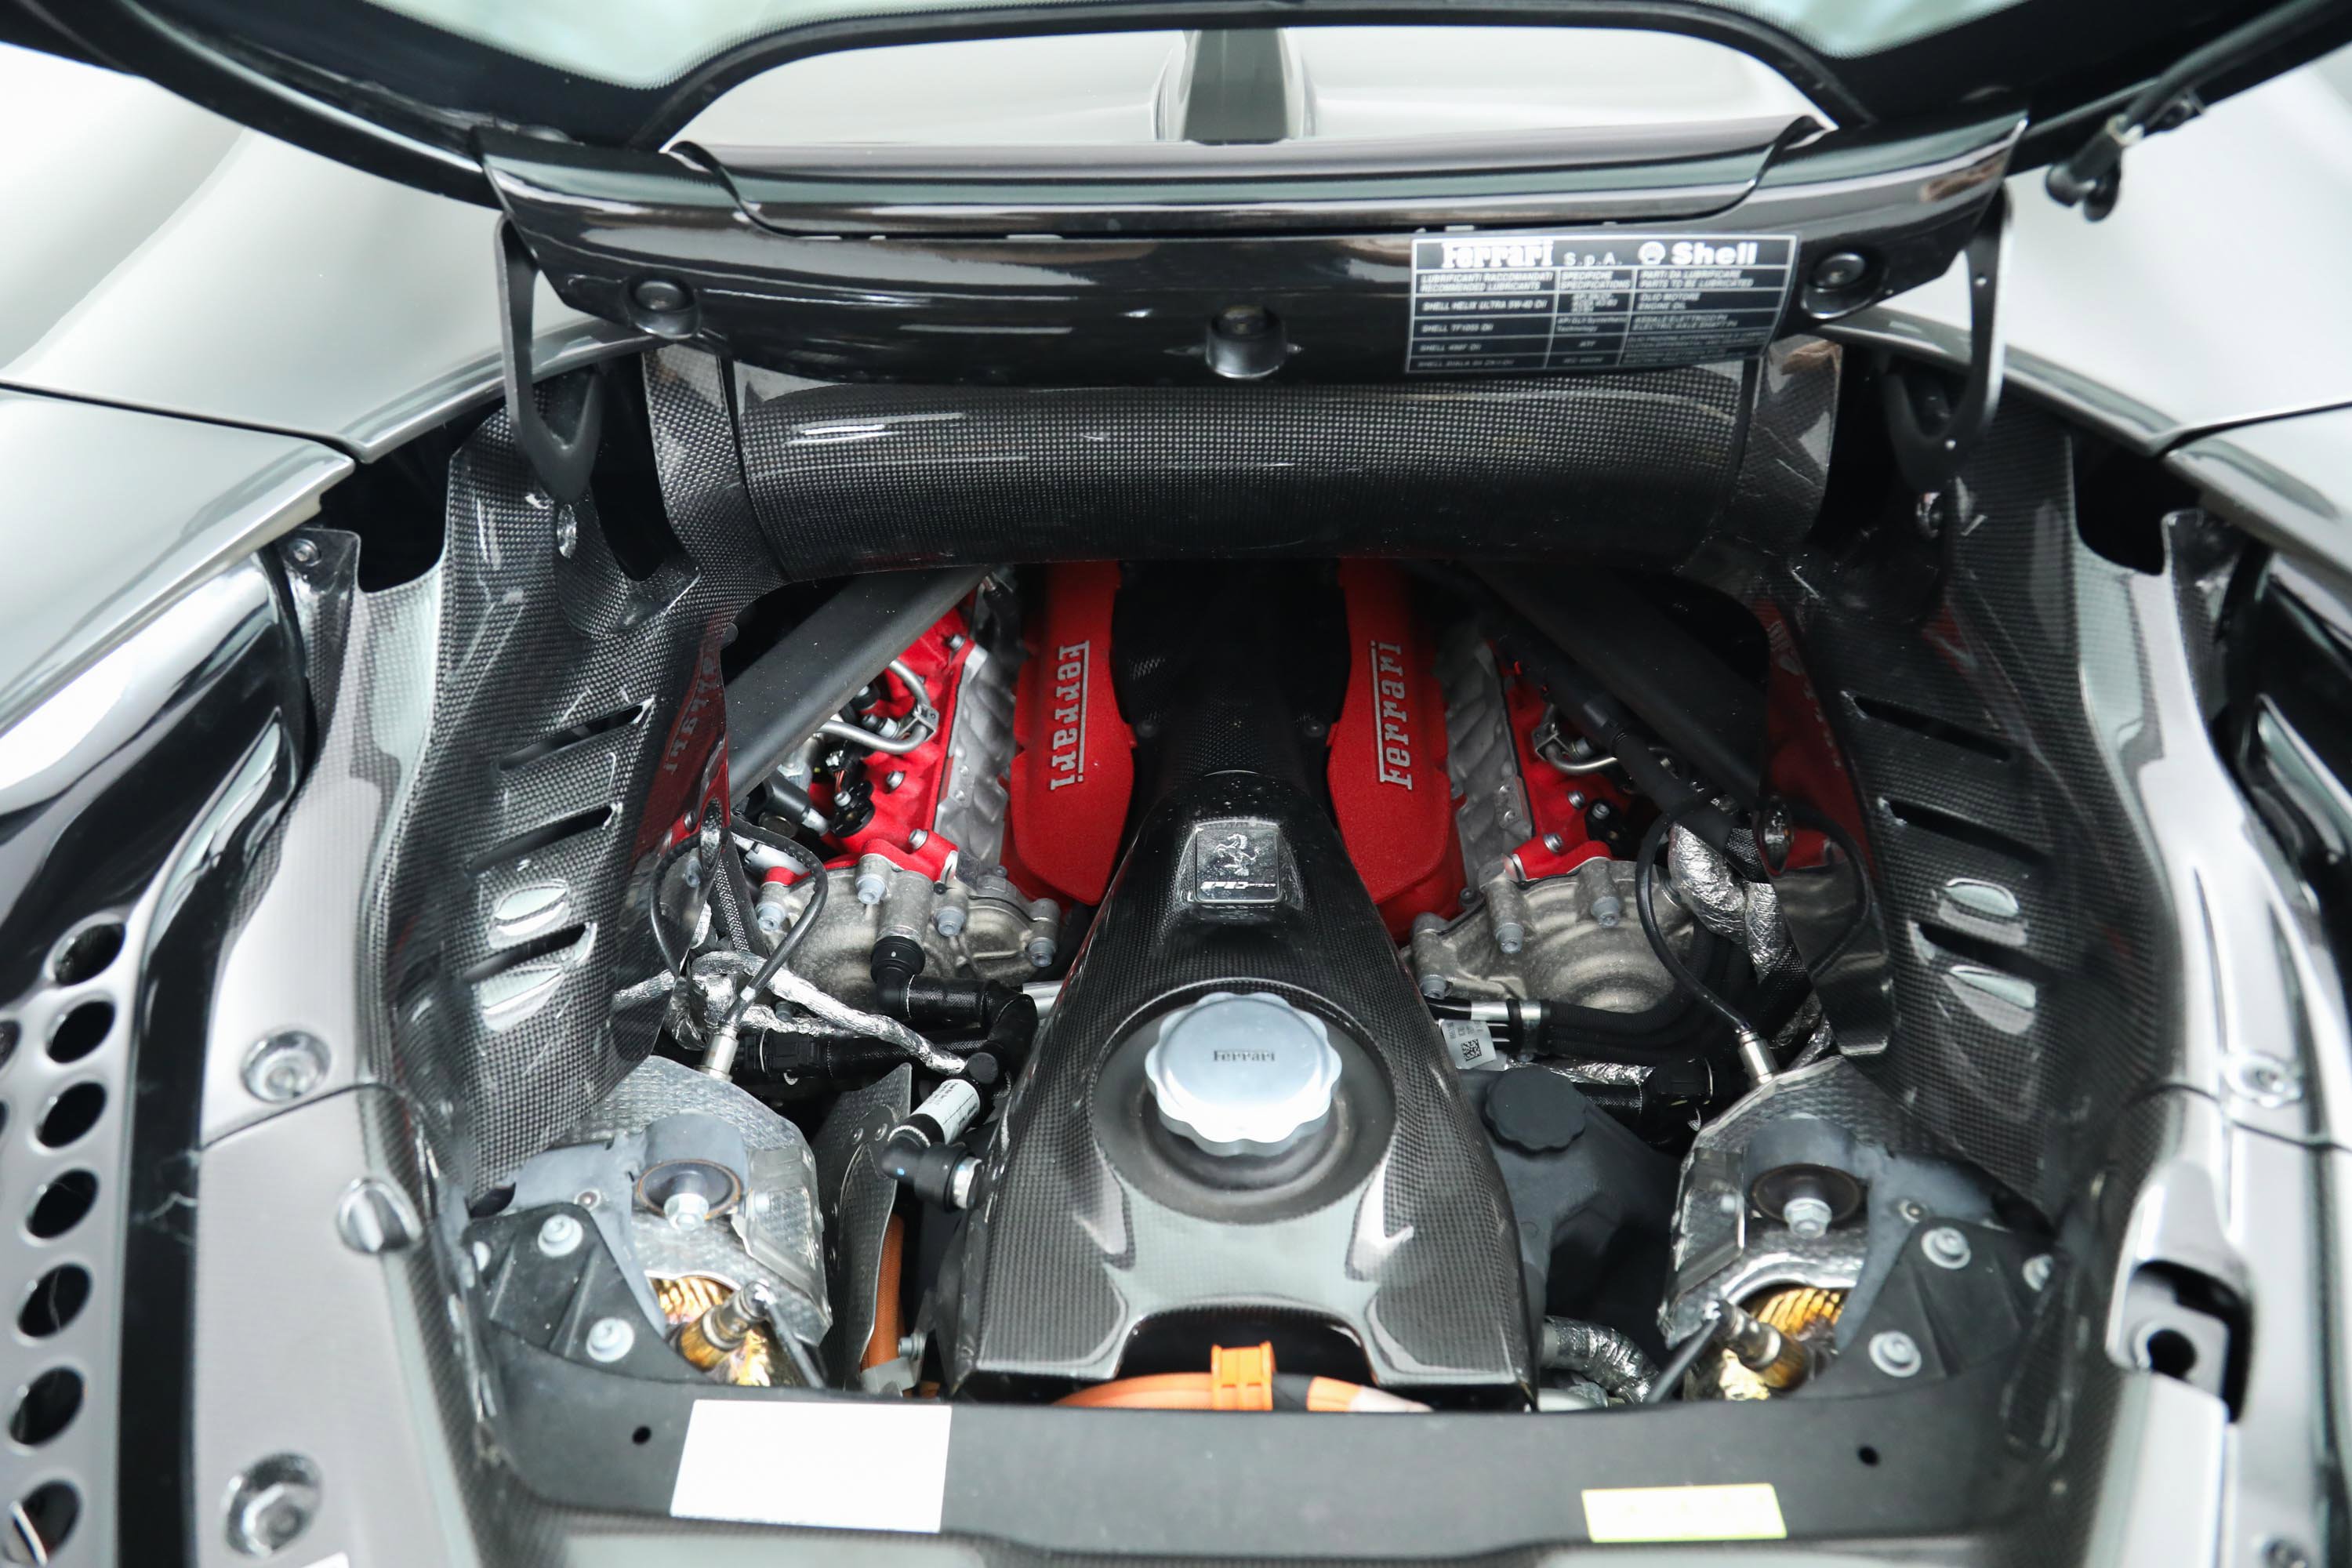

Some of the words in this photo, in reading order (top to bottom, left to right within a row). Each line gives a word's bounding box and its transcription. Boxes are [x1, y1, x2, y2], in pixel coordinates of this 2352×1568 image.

[1442, 238, 1553, 268] Ferrari
[1563, 251, 1623, 267] S.p.A.
[1671, 241, 1759, 265] Shell
[1421, 273, 1482, 283] LUBRIFICANTI
[1561, 279, 1631, 289] SPECIFICATIONS
[1639, 279, 1669, 289] PARTS
[1671, 278, 1683, 288] TO
[1686, 278, 1697, 288] BE
[1698, 278, 1754, 288] LUBRICATED
[1420, 282, 1486, 292] RECOMMENDED
[1487, 281, 1541, 292] LUBRICANTS
[1422, 302, 1450, 311] SHELL
[1051, 640, 1090, 790] Ferrari
[1371, 640, 1412, 790] Ferrari
[1214, 1049, 1275, 1062] Ferrari
